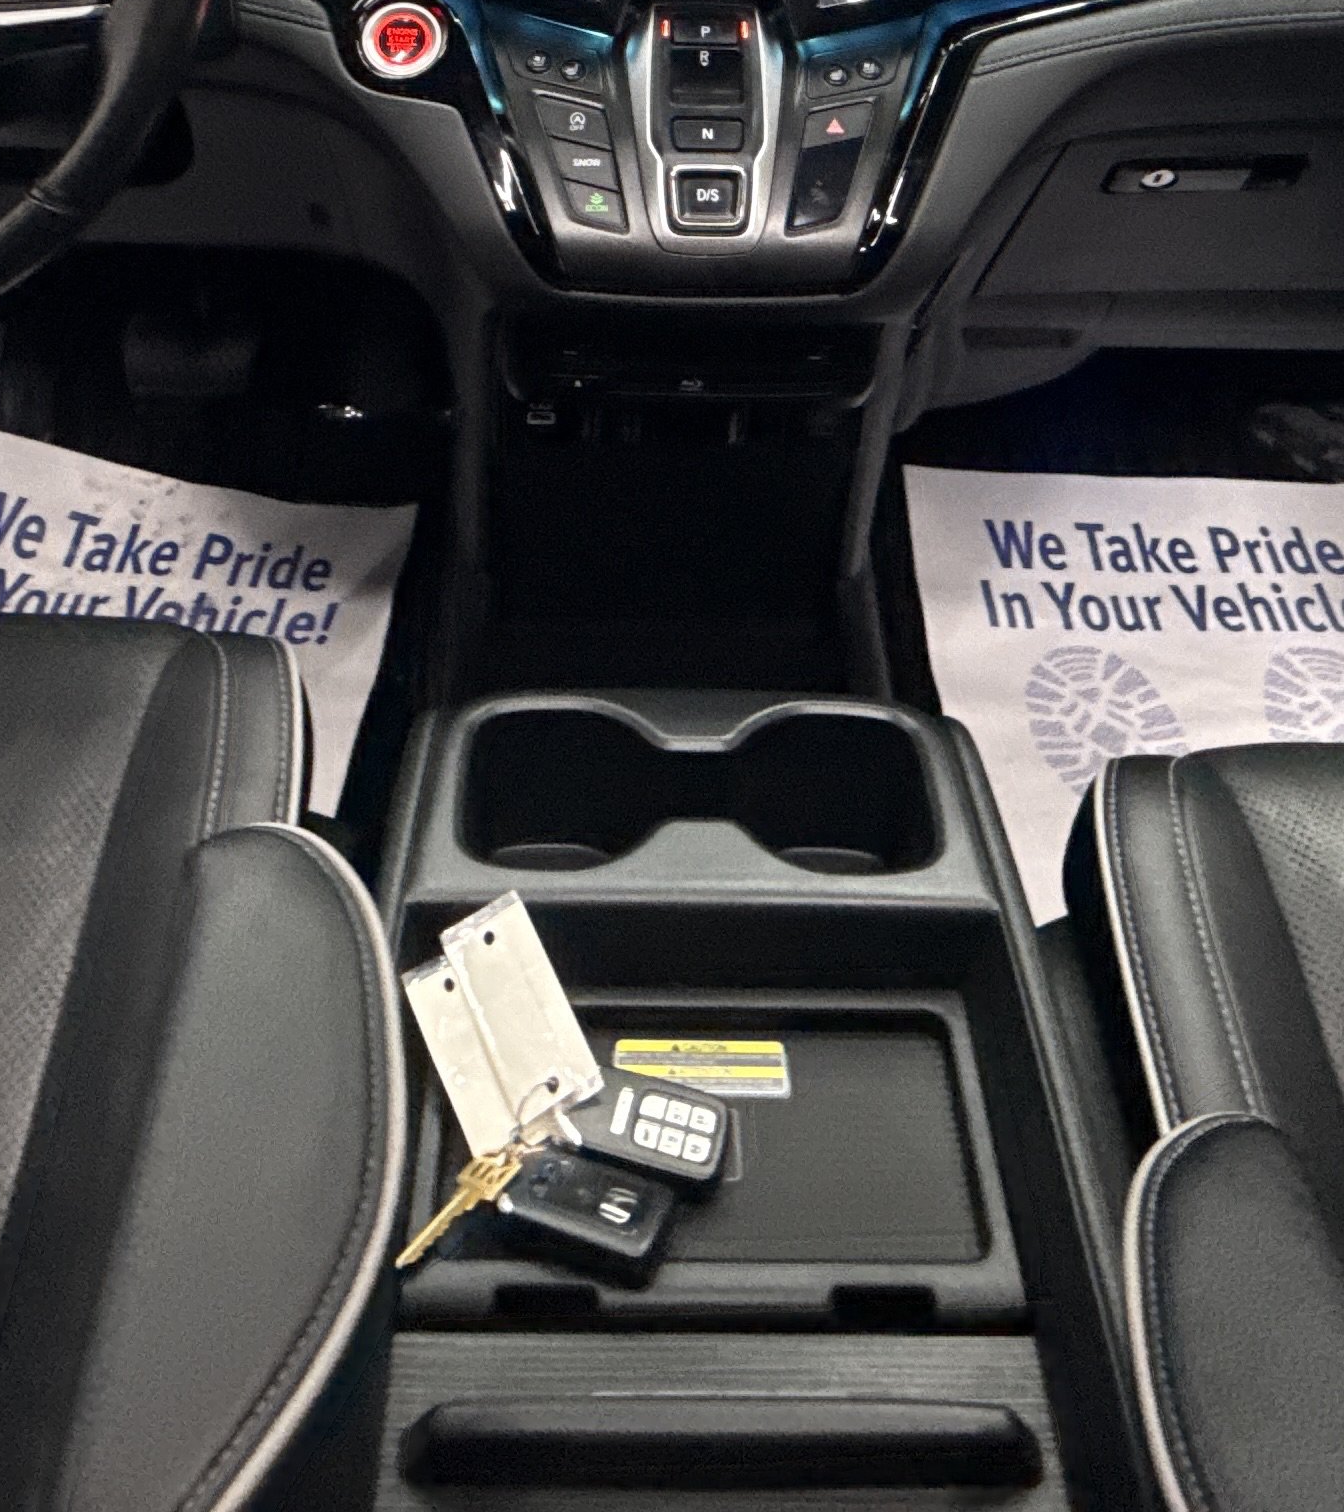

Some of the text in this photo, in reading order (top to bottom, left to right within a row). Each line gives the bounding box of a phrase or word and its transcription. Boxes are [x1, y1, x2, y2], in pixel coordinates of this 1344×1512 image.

[700, 25, 711, 38] P
[699, 50, 710, 63] R
[702, 128, 714, 140] N
[572, 158, 601, 167] SNOW
[696, 188, 720, 202] D/S
[62, 509, 179, 576] Take
[191, 532, 333, 592] Pride
[983, 519, 1068, 571] We
[1074, 522, 1199, 574] Take
[980, 580, 1034, 629] In
[1040, 582, 1162, 631] Your
